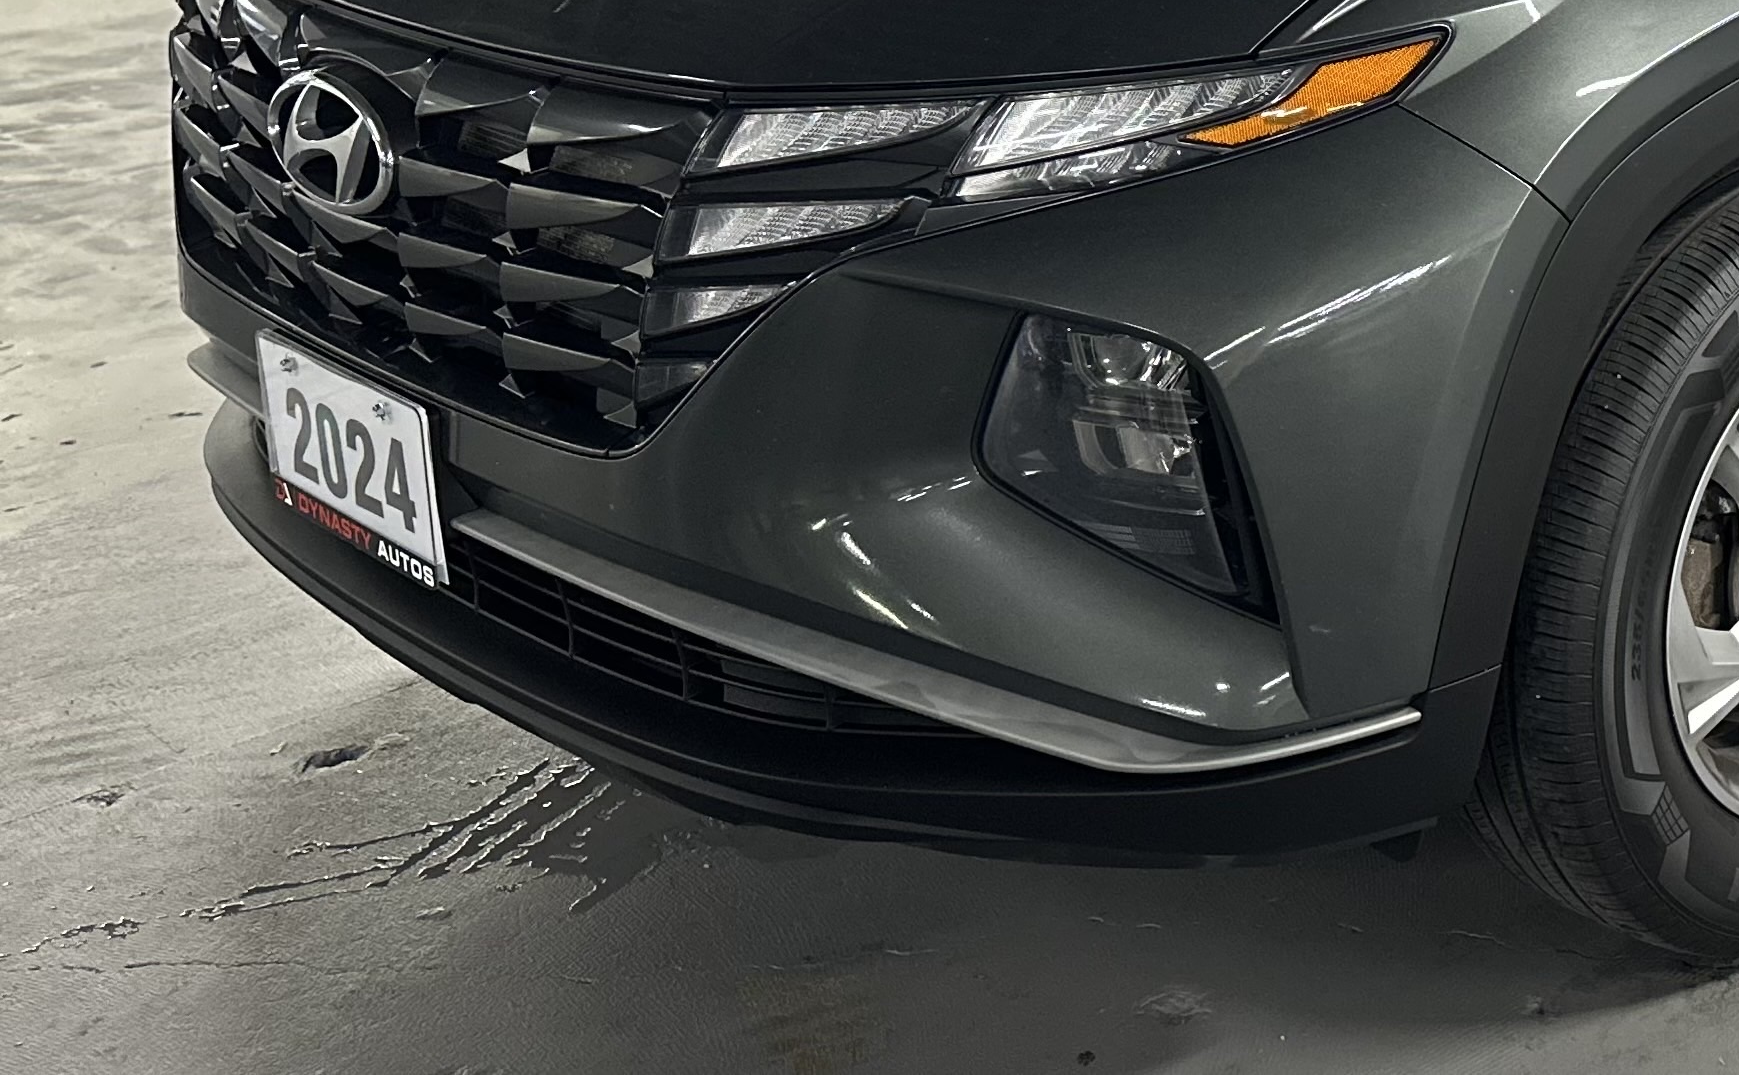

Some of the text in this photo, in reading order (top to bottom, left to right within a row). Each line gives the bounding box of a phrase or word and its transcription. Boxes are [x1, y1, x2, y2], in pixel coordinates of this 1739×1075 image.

[286, 387, 417, 534] 2024
[298, 493, 372, 550] DYNASTY
[377, 540, 435, 587] AUTOS
